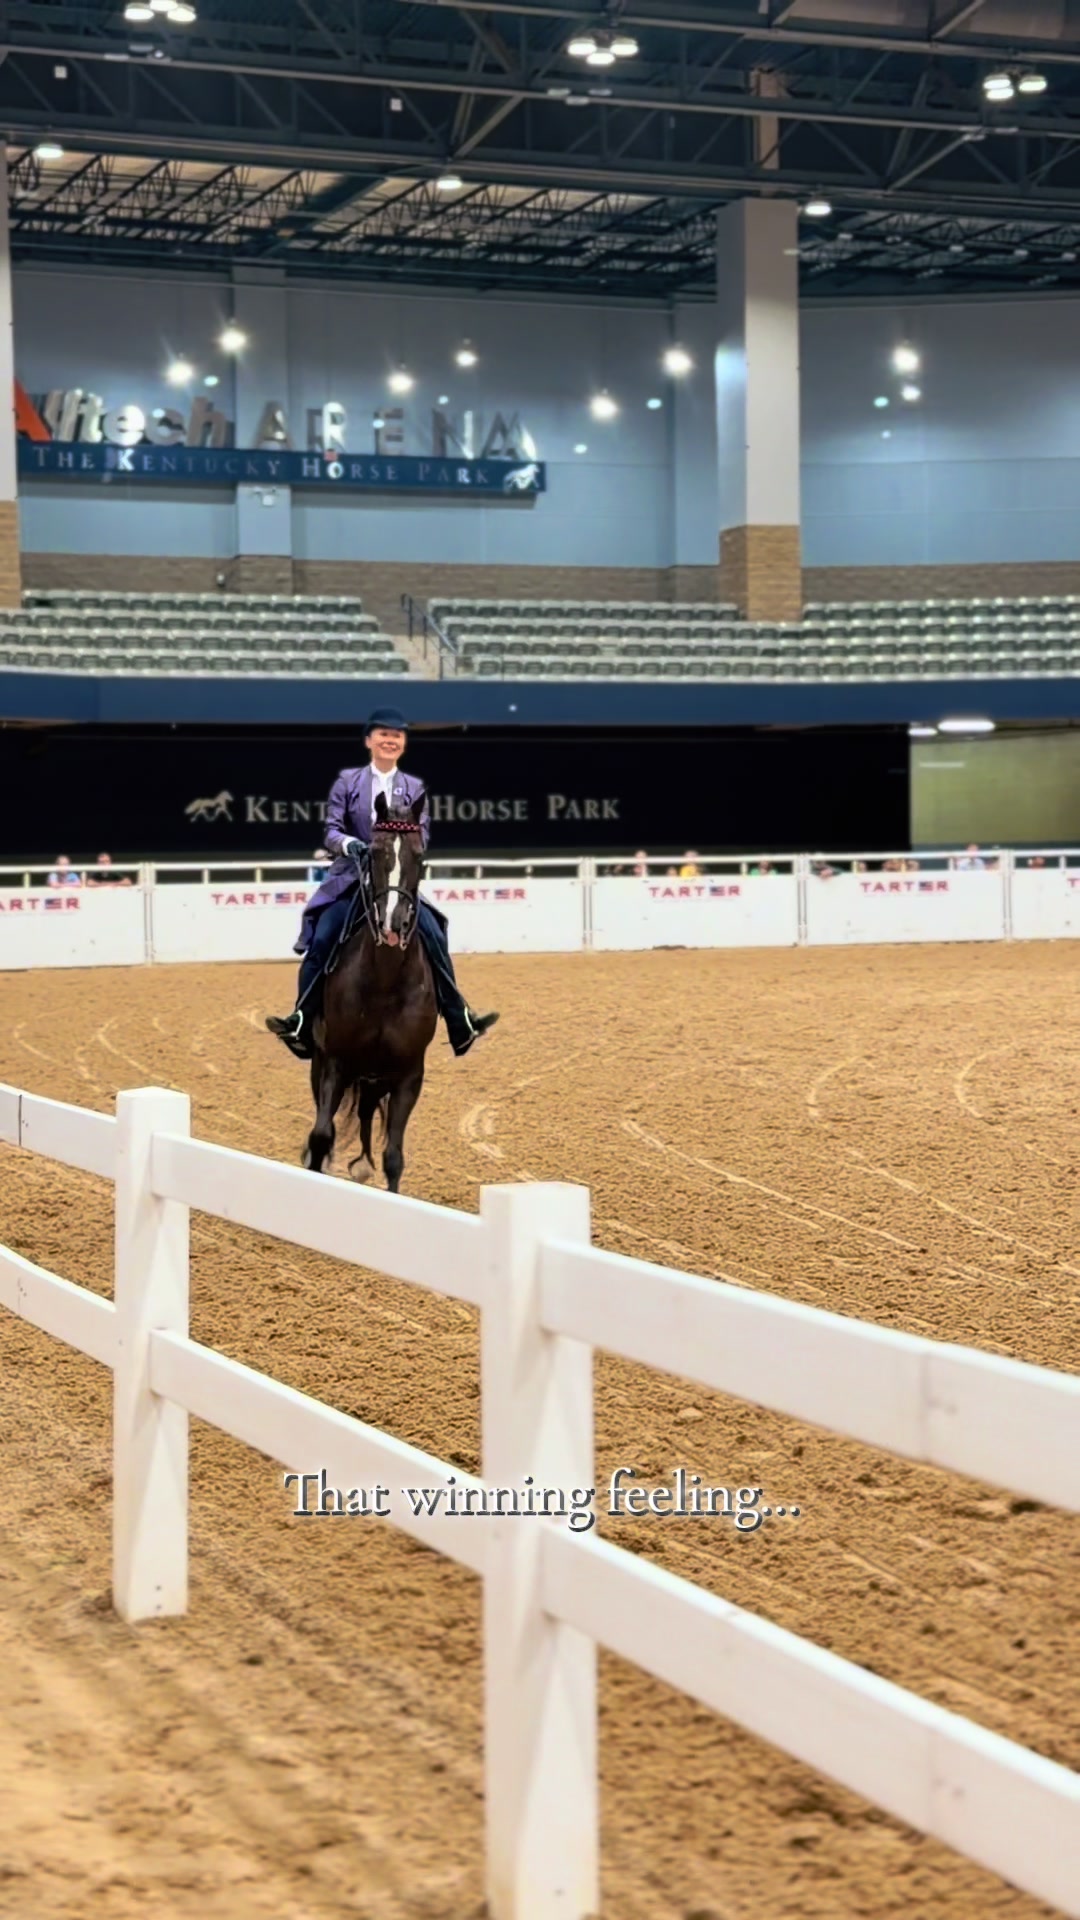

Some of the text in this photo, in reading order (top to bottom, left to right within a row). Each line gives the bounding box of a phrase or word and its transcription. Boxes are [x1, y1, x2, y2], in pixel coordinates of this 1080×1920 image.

[254, 402, 537, 462] ARENA
[33, 447, 489, 484] THE KENTUCKY HORSE PARK
[245, 794, 620, 822] KENT HORSE PARK
[432, 888, 526, 901] TARTER
[648, 885, 741, 898] TARTER
[860, 881, 949, 893] TARTER
